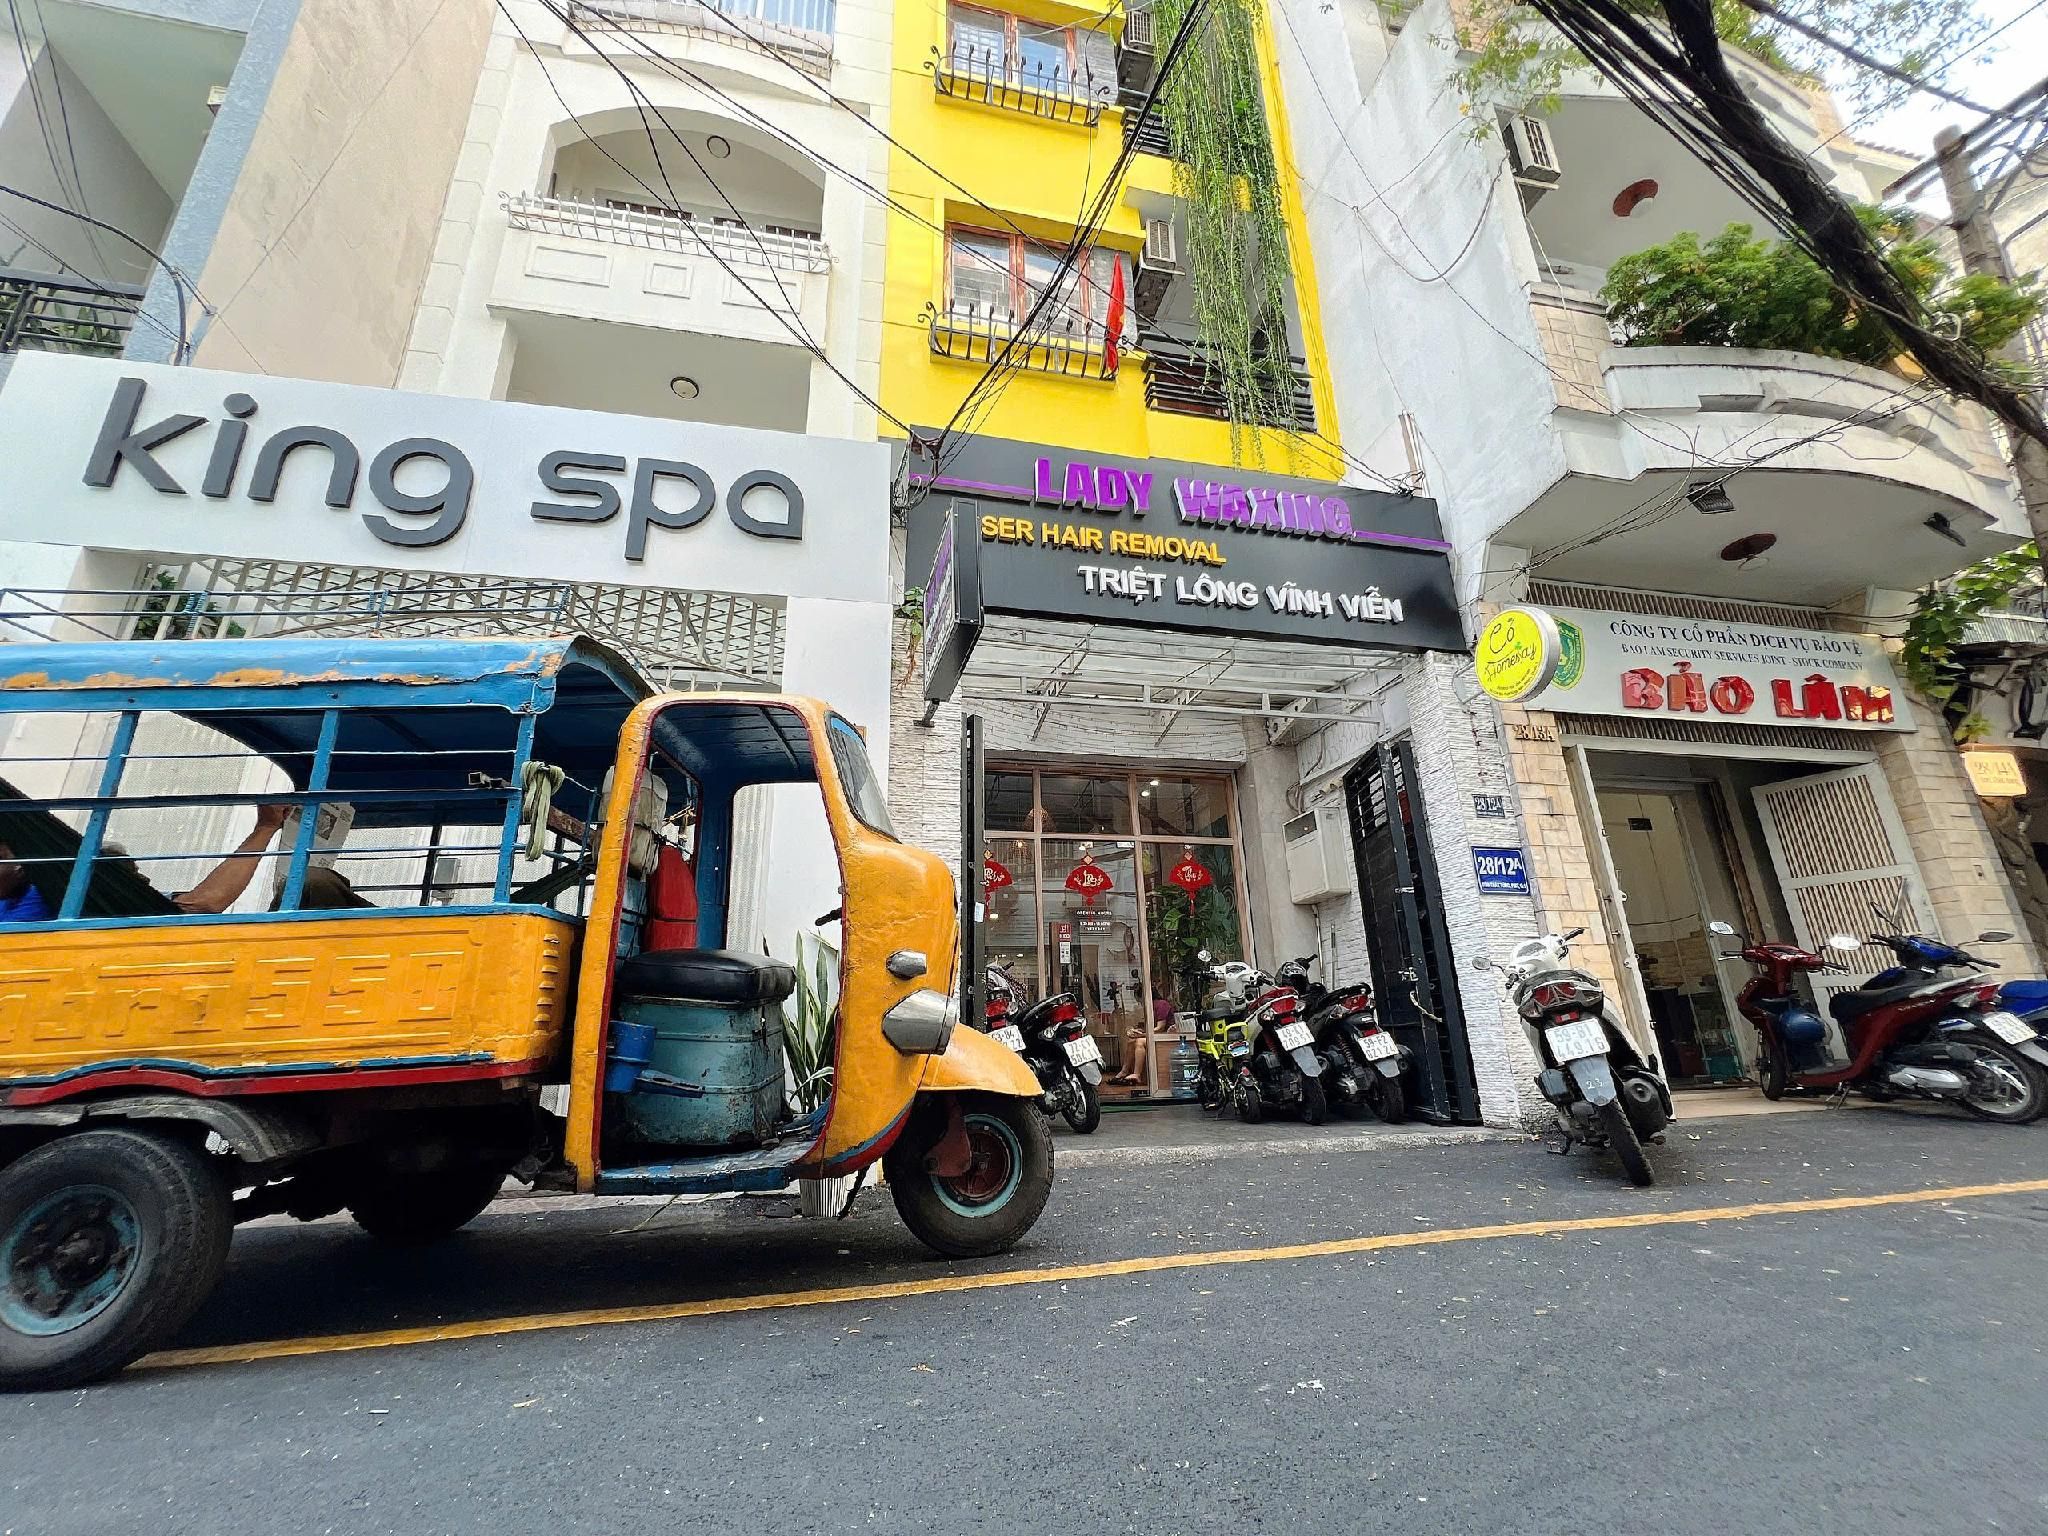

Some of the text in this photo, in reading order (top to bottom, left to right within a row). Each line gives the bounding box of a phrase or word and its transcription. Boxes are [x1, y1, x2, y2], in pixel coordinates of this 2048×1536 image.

[82, 376, 804, 562] king spa
[1034, 457, 1353, 540] LADY WAXING
[1041, 522, 1103, 549] HAIR
[1110, 529, 1227, 565] REMOVAL
[1077, 565, 1405, 623] TRIỆT LÔNG VĨNH VIỄN
[1610, 620, 1655, 639] CÔNG
[1658, 626, 1678, 640] TY
[1749, 633, 1788, 650] DỊCH
[1789, 637, 1810, 653] VỤ
[1813, 636, 1841, 653] BẢO
[1667, 647, 1712, 659] SECURITY
[1714, 650, 1759, 663] SERVICES
[1620, 661, 1895, 723] BẢO LÂM
